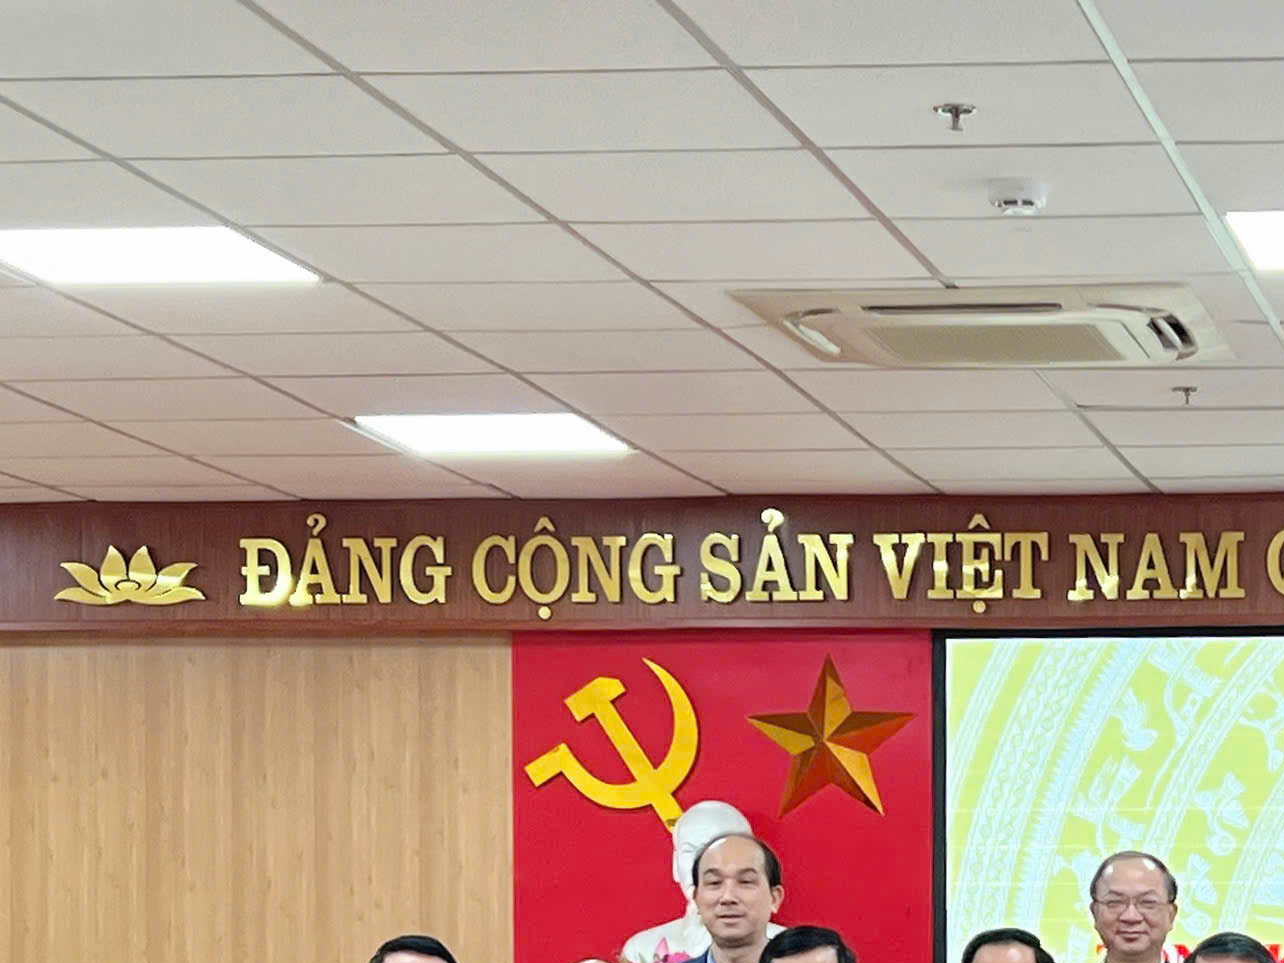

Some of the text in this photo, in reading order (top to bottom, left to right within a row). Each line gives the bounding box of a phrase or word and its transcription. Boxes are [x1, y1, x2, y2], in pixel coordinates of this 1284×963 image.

[239, 513, 453, 605] ĐẢNG
[472, 516, 681, 619] CỘNG
[700, 507, 854, 603] SẢN
[873, 513, 1049, 613] VIỆT
[1068, 531, 1246, 601] NAM
